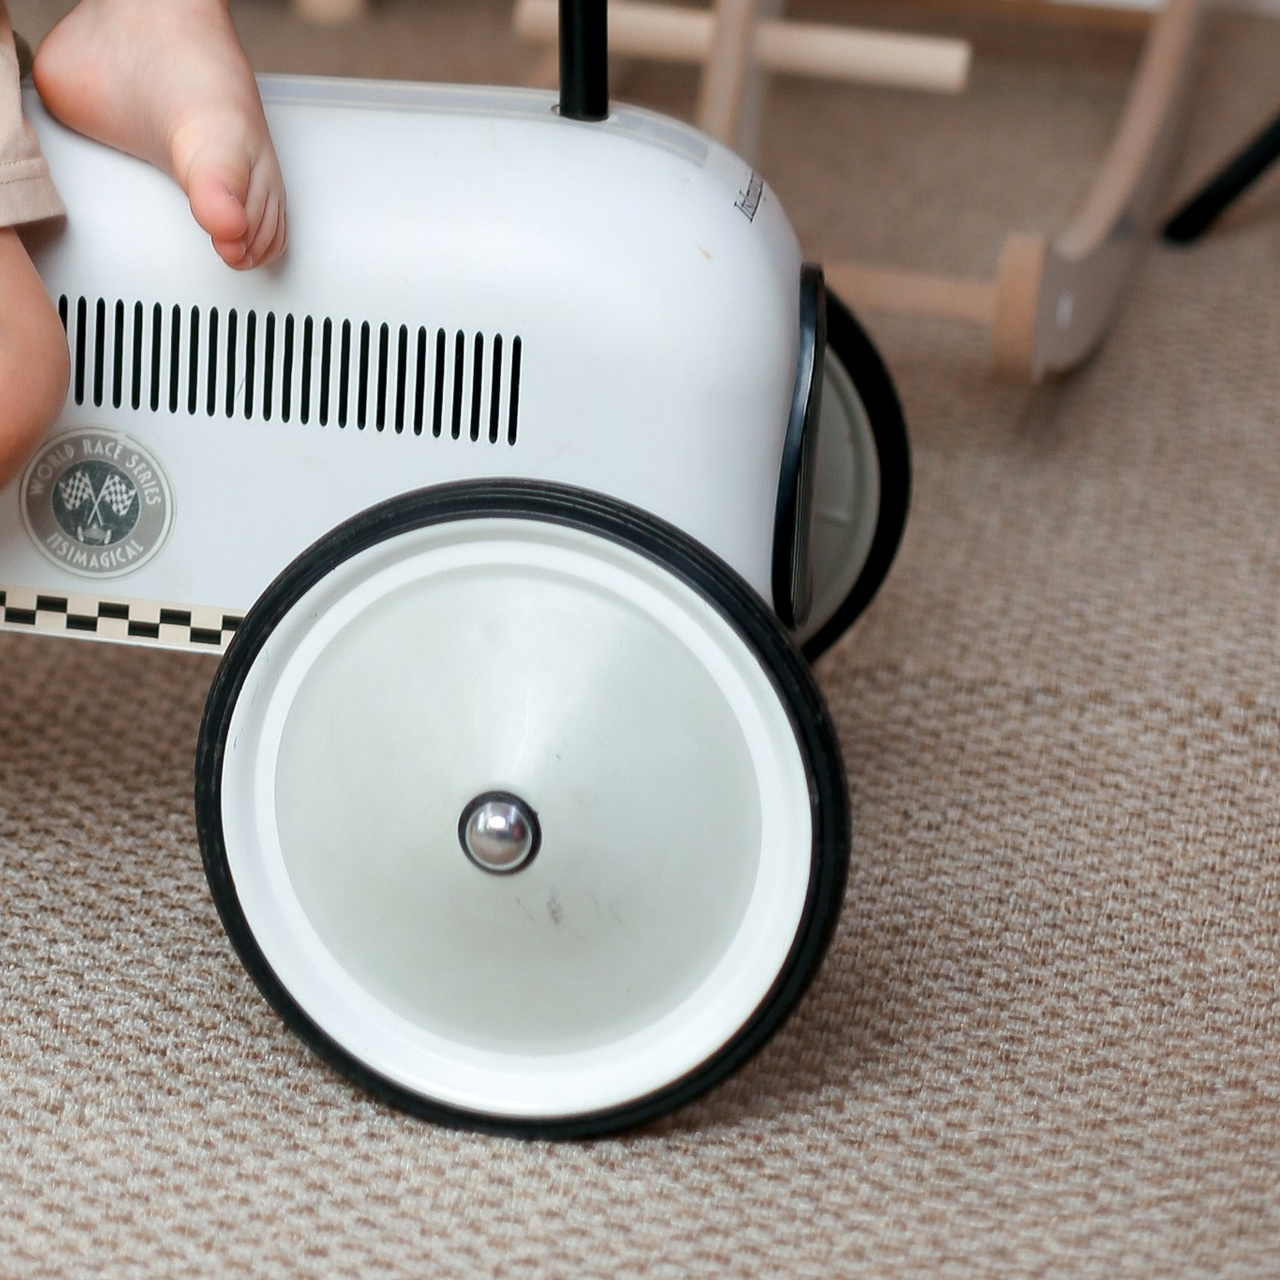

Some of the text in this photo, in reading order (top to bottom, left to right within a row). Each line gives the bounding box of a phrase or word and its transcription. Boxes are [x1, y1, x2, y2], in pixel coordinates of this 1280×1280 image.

[31, 439, 161, 505] WORLD RACE SERIES
[47, 533, 143, 568] ITSIMAGICAL
